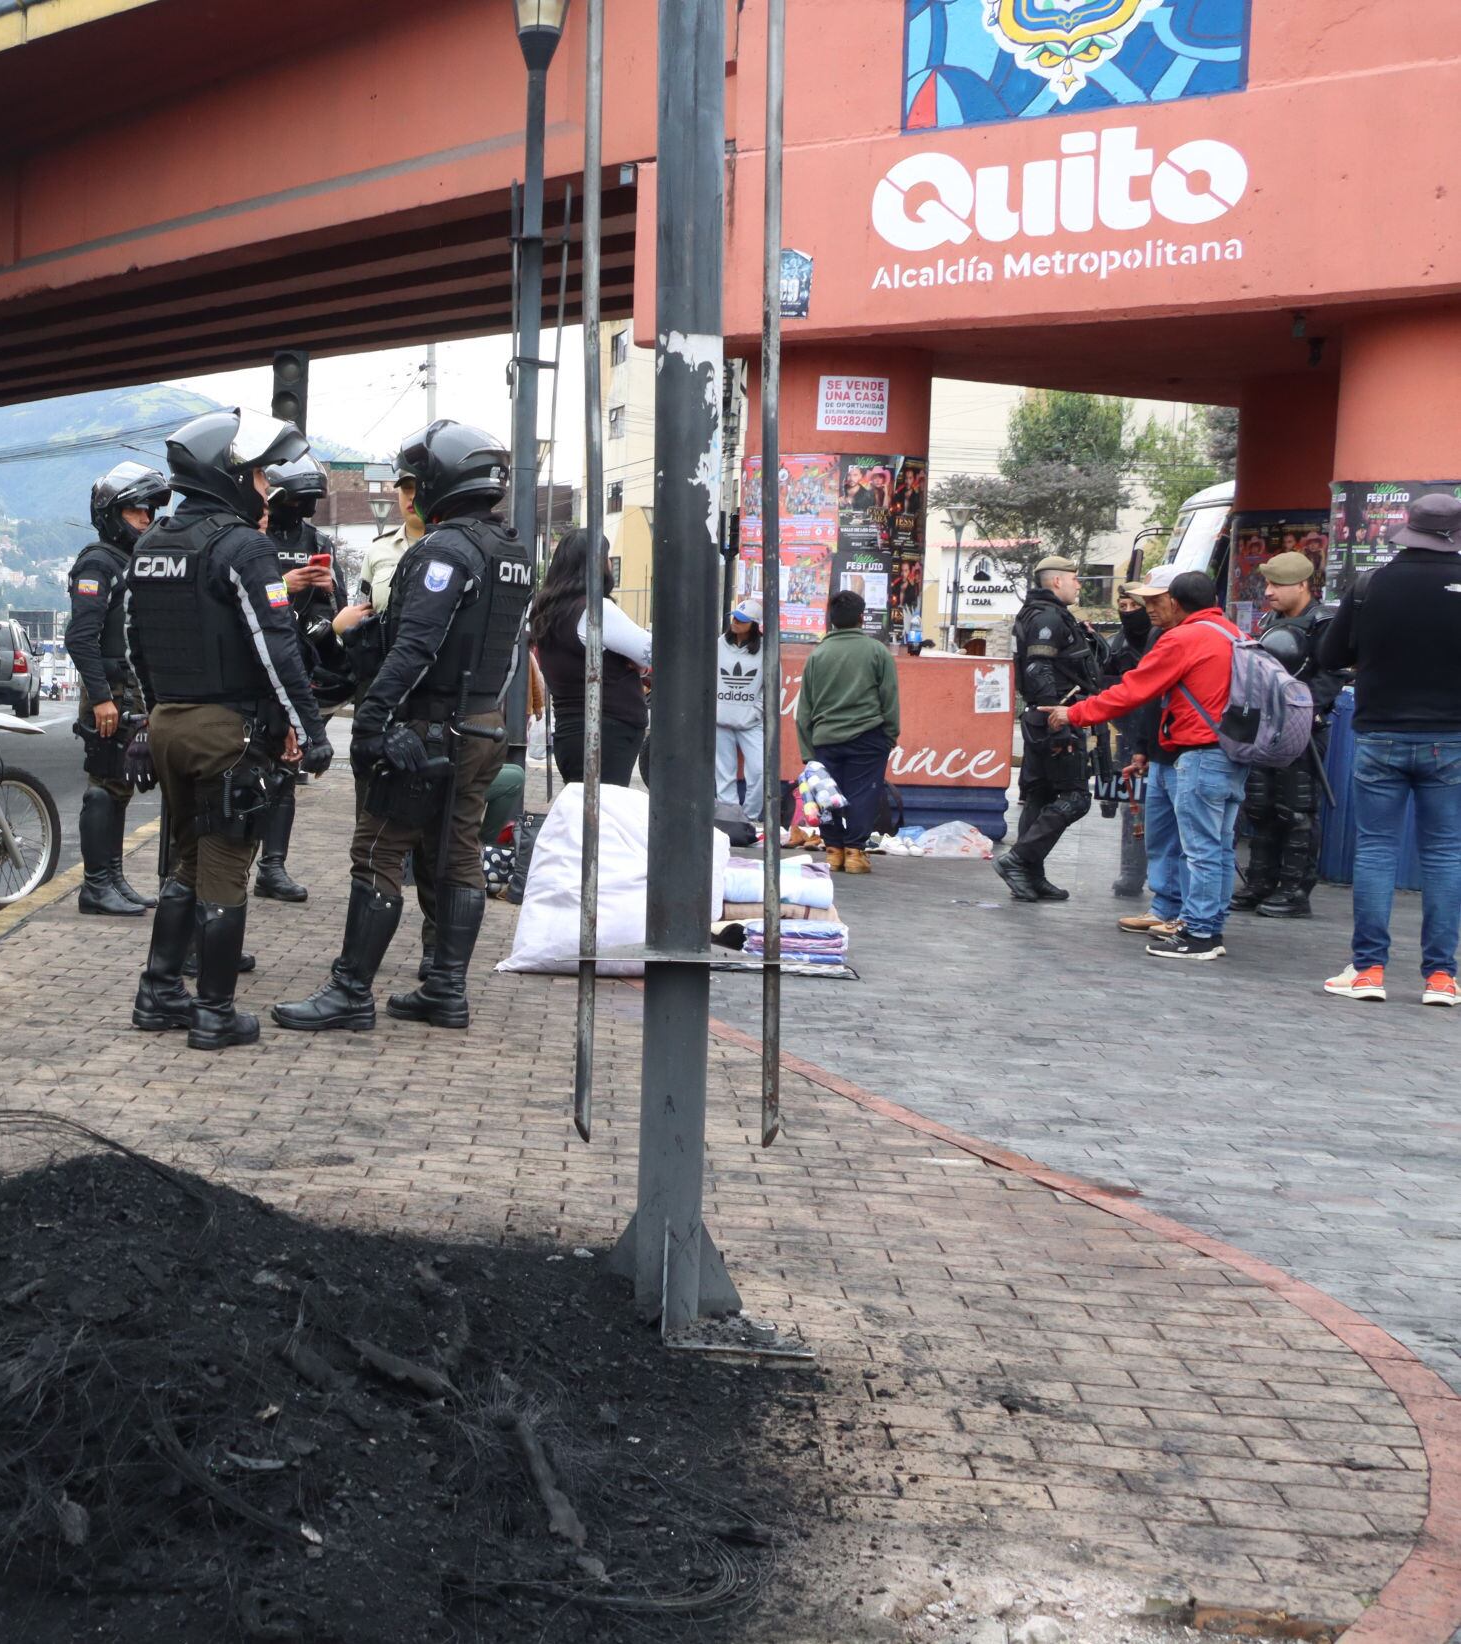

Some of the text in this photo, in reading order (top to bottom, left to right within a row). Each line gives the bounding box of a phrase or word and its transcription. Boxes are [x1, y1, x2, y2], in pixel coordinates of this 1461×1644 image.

[871, 126, 1249, 251] Quito
[871, 238, 1243, 290] Alcaldía Metropolitana
[826, 380, 885, 391] SE VENDE
[825, 391, 885, 402] UNA CASA
[824, 415, 884, 427] 0982824007
[1366, 493, 1388, 503] FEST
[134, 556, 187, 578] GOM
[846, 562, 868, 571] FEST
[499, 561, 532, 586] OTM
[947, 585, 1015, 593] LS CUADRAS
[971, 598, 992, 606] ETAPA
[717, 690, 755, 702] adidas
